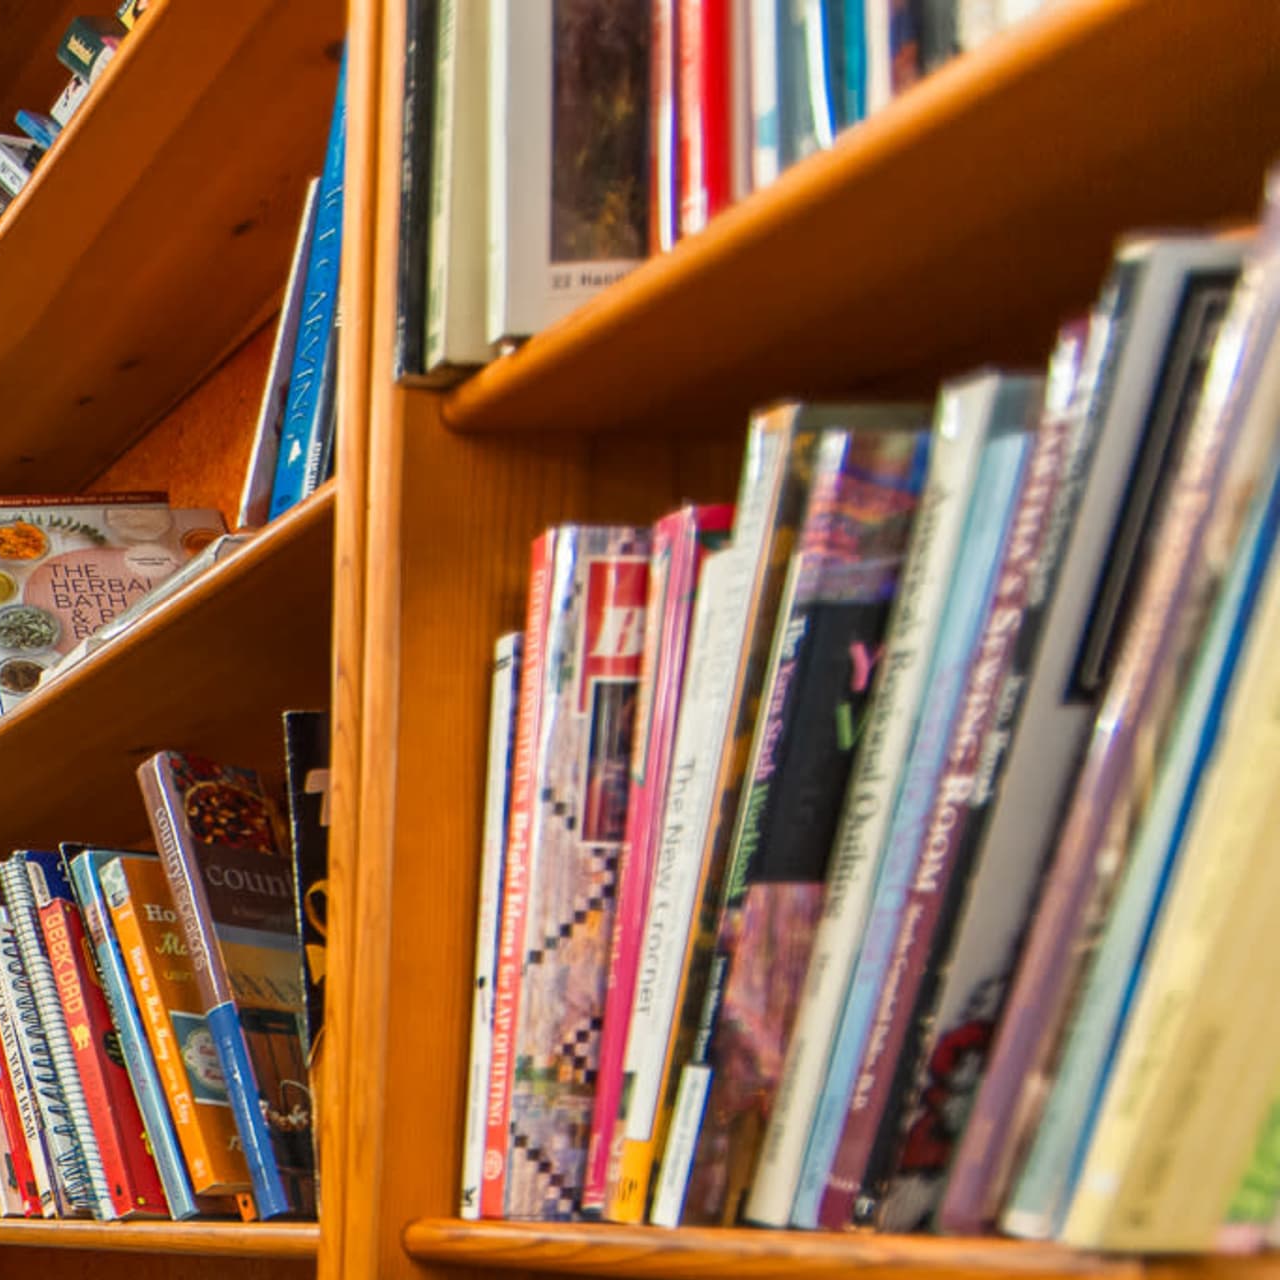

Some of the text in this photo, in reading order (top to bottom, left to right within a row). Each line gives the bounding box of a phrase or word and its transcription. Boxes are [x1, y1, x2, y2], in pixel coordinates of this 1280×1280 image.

[49, 563, 100, 579] THE
[54, 592, 128, 609] BATH
[728, 616, 809, 902] The Yarn Stash Workbook
[44, 911, 84, 1014] GEEK DAD
[487, 810, 532, 1128] Bright Ideas for LAP QUILTING
[7, 1055, 26, 1095] YOUR
[16, 1098, 37, 1143] HOME
